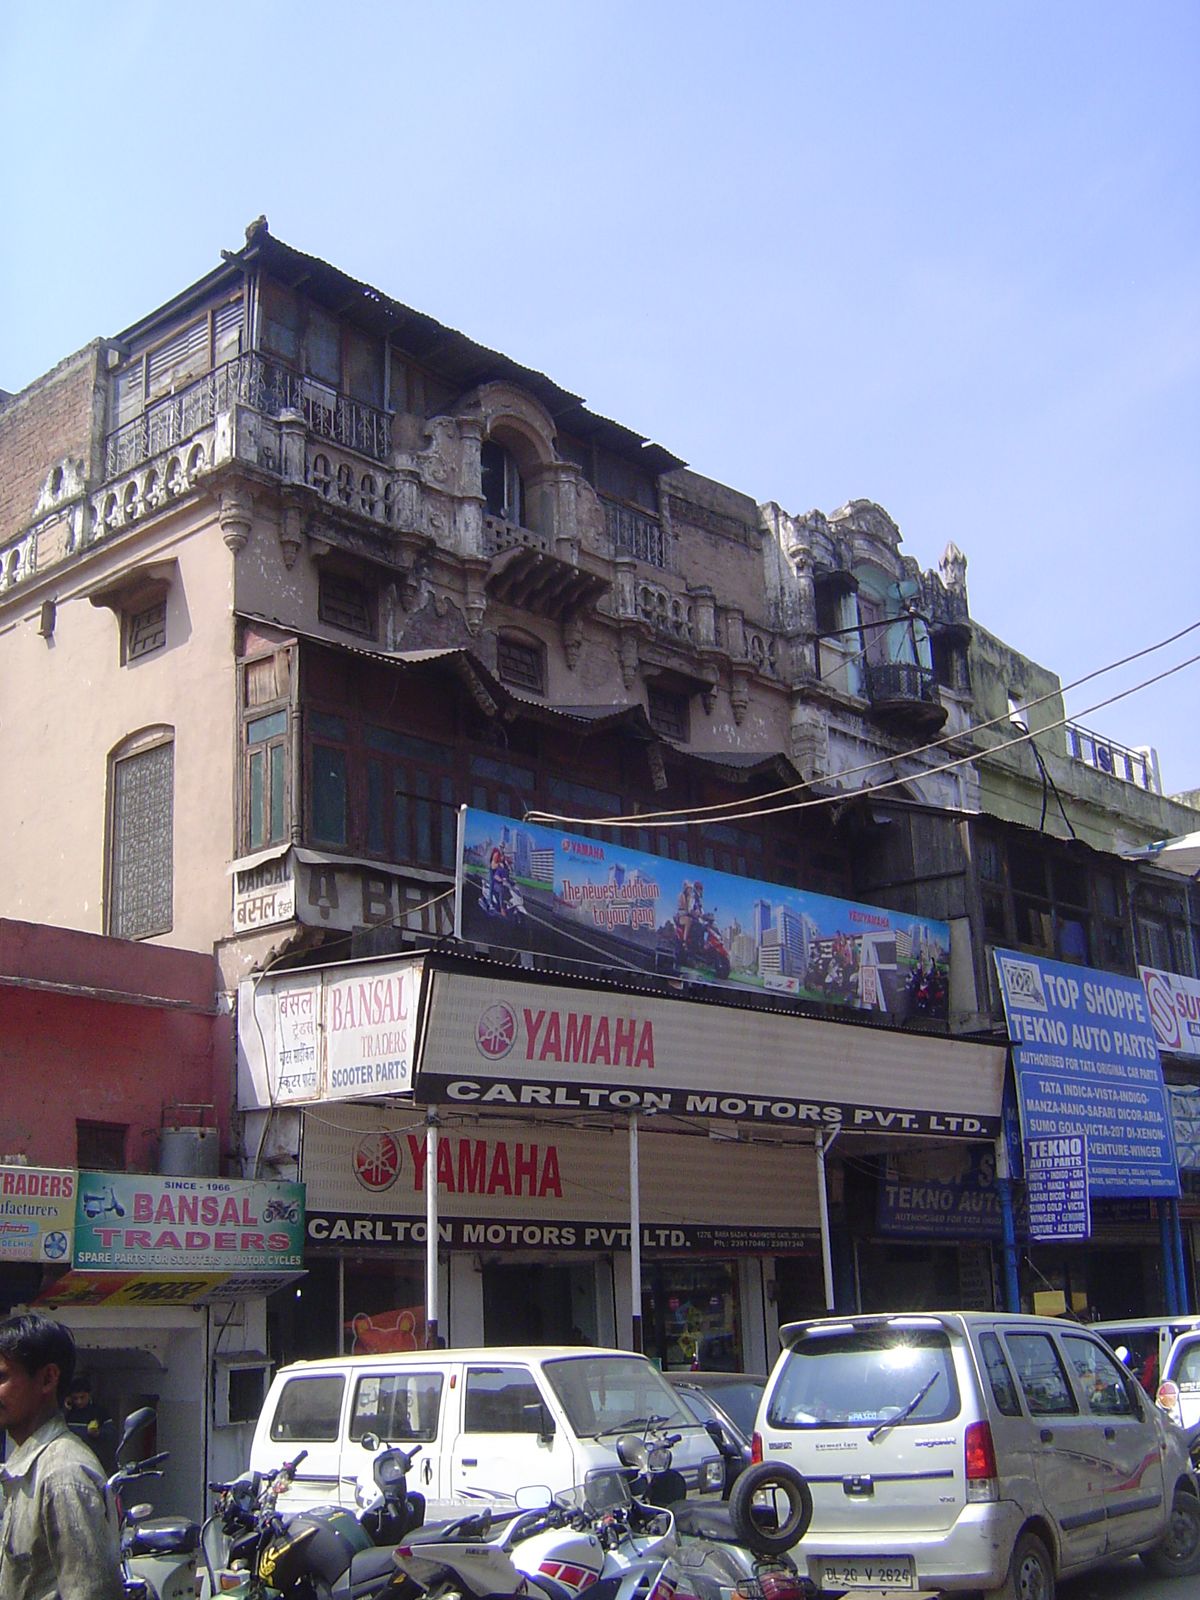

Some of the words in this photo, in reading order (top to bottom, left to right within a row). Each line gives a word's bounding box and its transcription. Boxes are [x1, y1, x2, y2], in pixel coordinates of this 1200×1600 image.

[571, 839, 605, 860] YAMAHA
[562, 880, 580, 900] The
[583, 880, 619, 899] newest
[621, 879, 660, 899] addition
[593, 905, 605, 925] to
[606, 908, 629, 930] your
[631, 908, 655, 929] gang
[279, 990, 313, 1018] बंसल
[331, 976, 408, 1032] BANSAL
[1043, 973, 1080, 1012] TOP
[1083, 981, 1146, 1024] SHOPPE
[361, 1029, 407, 1058] TRADERS
[523, 1008, 654, 1068] YAMAHA
[1010, 1013, 1068, 1047] TEKNO
[1072, 1024, 1111, 1053] AUTO
[1113, 1031, 1157, 1061] PARTS
[331, 1064, 373, 1088] SCOOTER
[375, 1060, 407, 1082] PARTS
[1020, 1051, 1064, 1069] AUTHORISED
[1065, 1057, 1079, 1071] FOR
[1080, 1060, 1096, 1073] TATA
[1127, 1066, 1139, 1079] CAR
[1140, 1068, 1159, 1082] PARTS
[1039, 1081, 1062, 1095] TATA
[446, 1081, 671, 1110] CARLTON
[686, 1094, 842, 1122] MOTORS
[854, 1109, 919, 1129] PVT.
[928, 1115, 988, 1133] LTD.
[1030, 1119, 1056, 1132] SUMO
[1028, 1138, 1082, 1158] TEKNO
[407, 1135, 562, 1198] YAMAHA
[1030, 1157, 1053, 1168] AUTO
[1054, 1156, 1082, 1168] PARTS
[164, 1181, 197, 1191] SINCE
[207, 1183, 231, 1192] 1966
[886, 1184, 953, 1211] TEKNO
[134, 1193, 258, 1226] BANSAL
[93, 1228, 291, 1252] TRADERS
[308, 1218, 452, 1243] CARLTON
[463, 1224, 576, 1246] MOTORS
[643, 1230, 692, 1248] LTD.
[78, 1251, 112, 1264] SPARE
[114, 1252, 146, 1265] PARTS
[149, 1253, 169, 1265] FOR
[170, 1254, 221, 1266] SCOOTERS
[234, 1255, 266, 1266] MOTOR
[268, 1255, 302, 1266] CYCLES
[825, 1568, 841, 1581] DL
[865, 1568, 873, 1581] V
